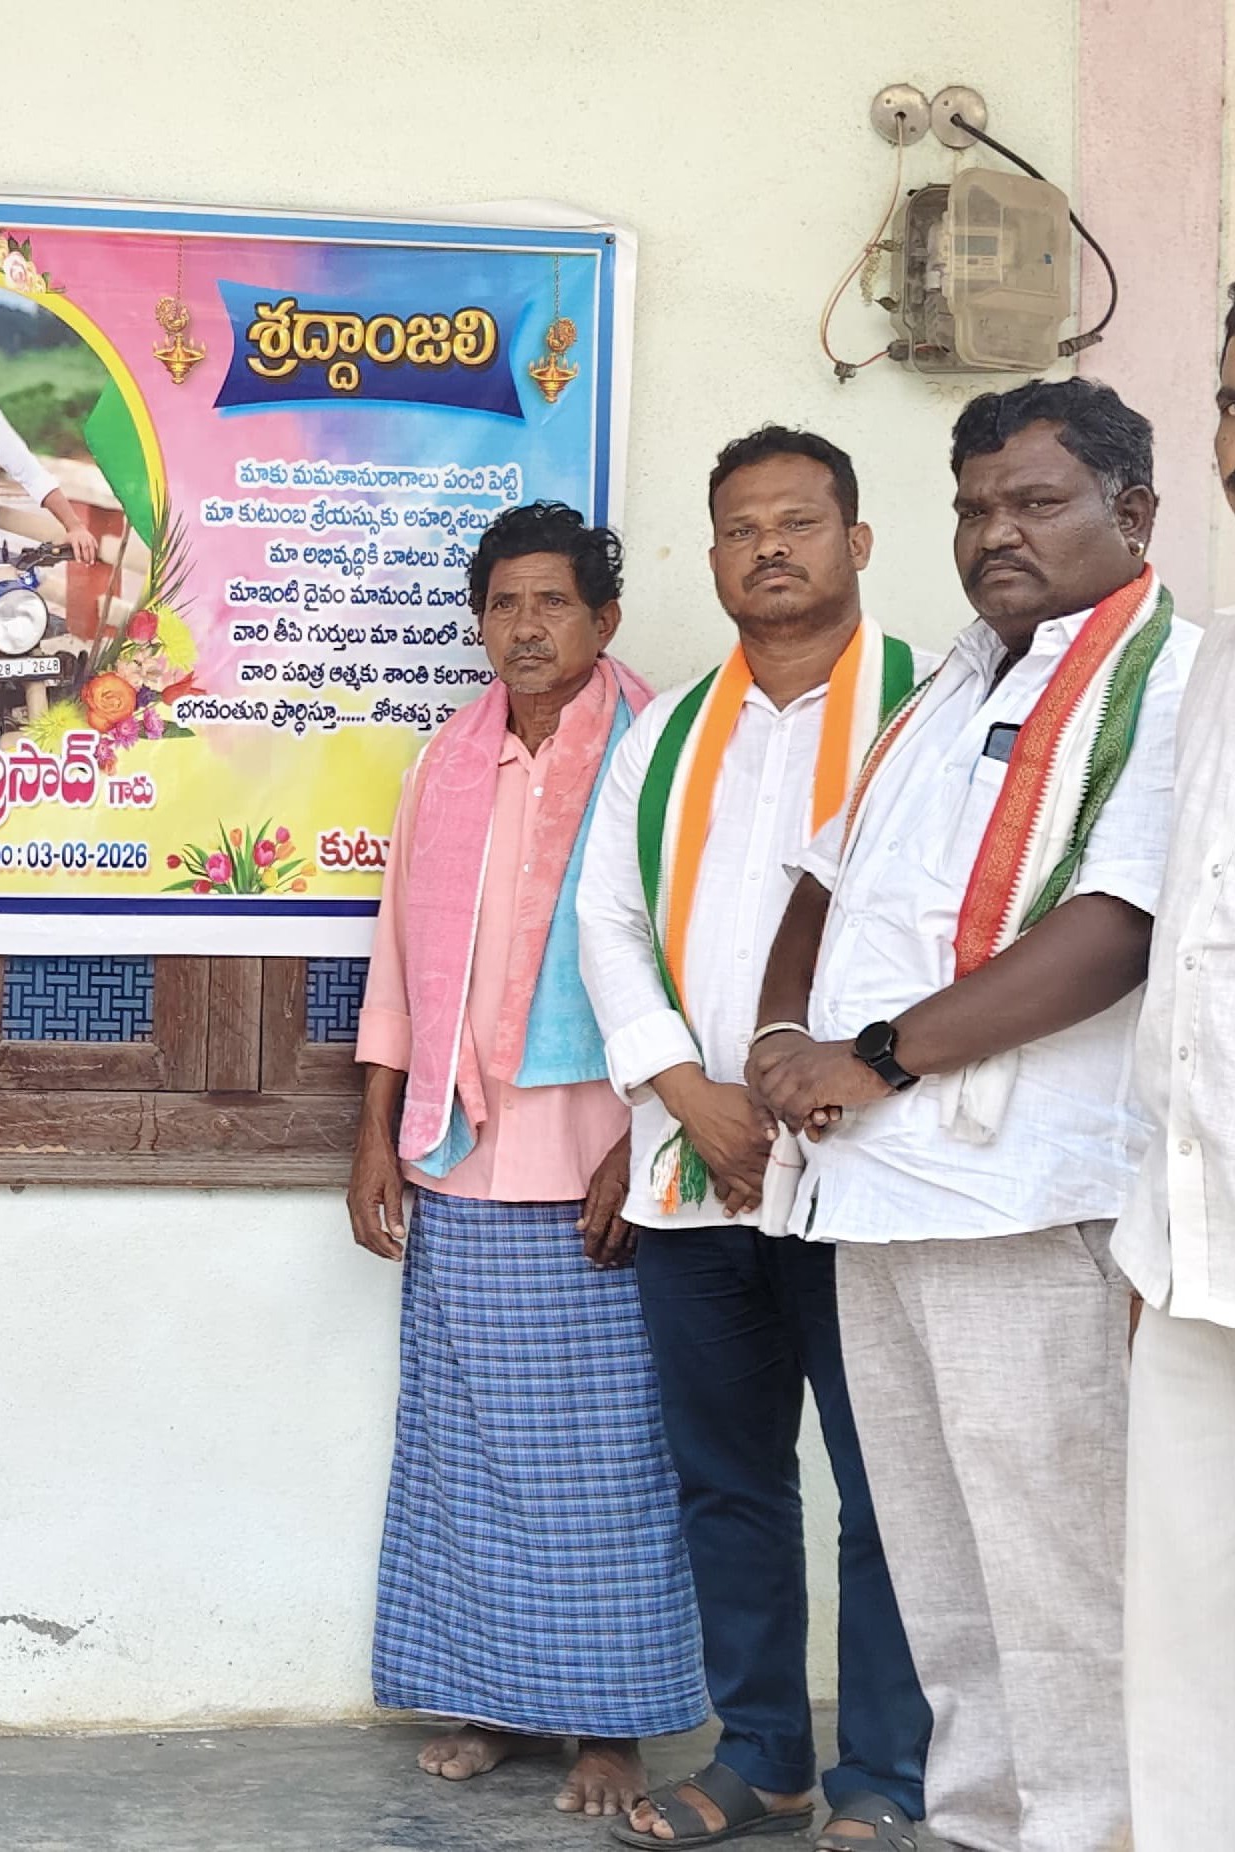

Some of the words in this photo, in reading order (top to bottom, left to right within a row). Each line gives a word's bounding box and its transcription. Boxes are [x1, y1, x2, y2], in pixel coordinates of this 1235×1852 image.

[240, 463, 288, 484] మాకు
[205, 501, 234, 522] మా
[239, 503, 307, 524] కుటుంబ
[270, 543, 298, 562] మా
[383, 547, 439, 567] బాటలు
[303, 583, 346, 612] దైవం
[233, 624, 269, 642] వారి
[307, 623, 366, 651] గుర్తులు
[370, 624, 398, 644] మా
[241, 664, 277, 681] వారి
[282, 661, 325, 689] పవిత్ర
[382, 665, 429, 684] శాంతి
[177, 699, 268, 722] భగవంతుని
[27, 842, 147, 869] 03-03-2026
